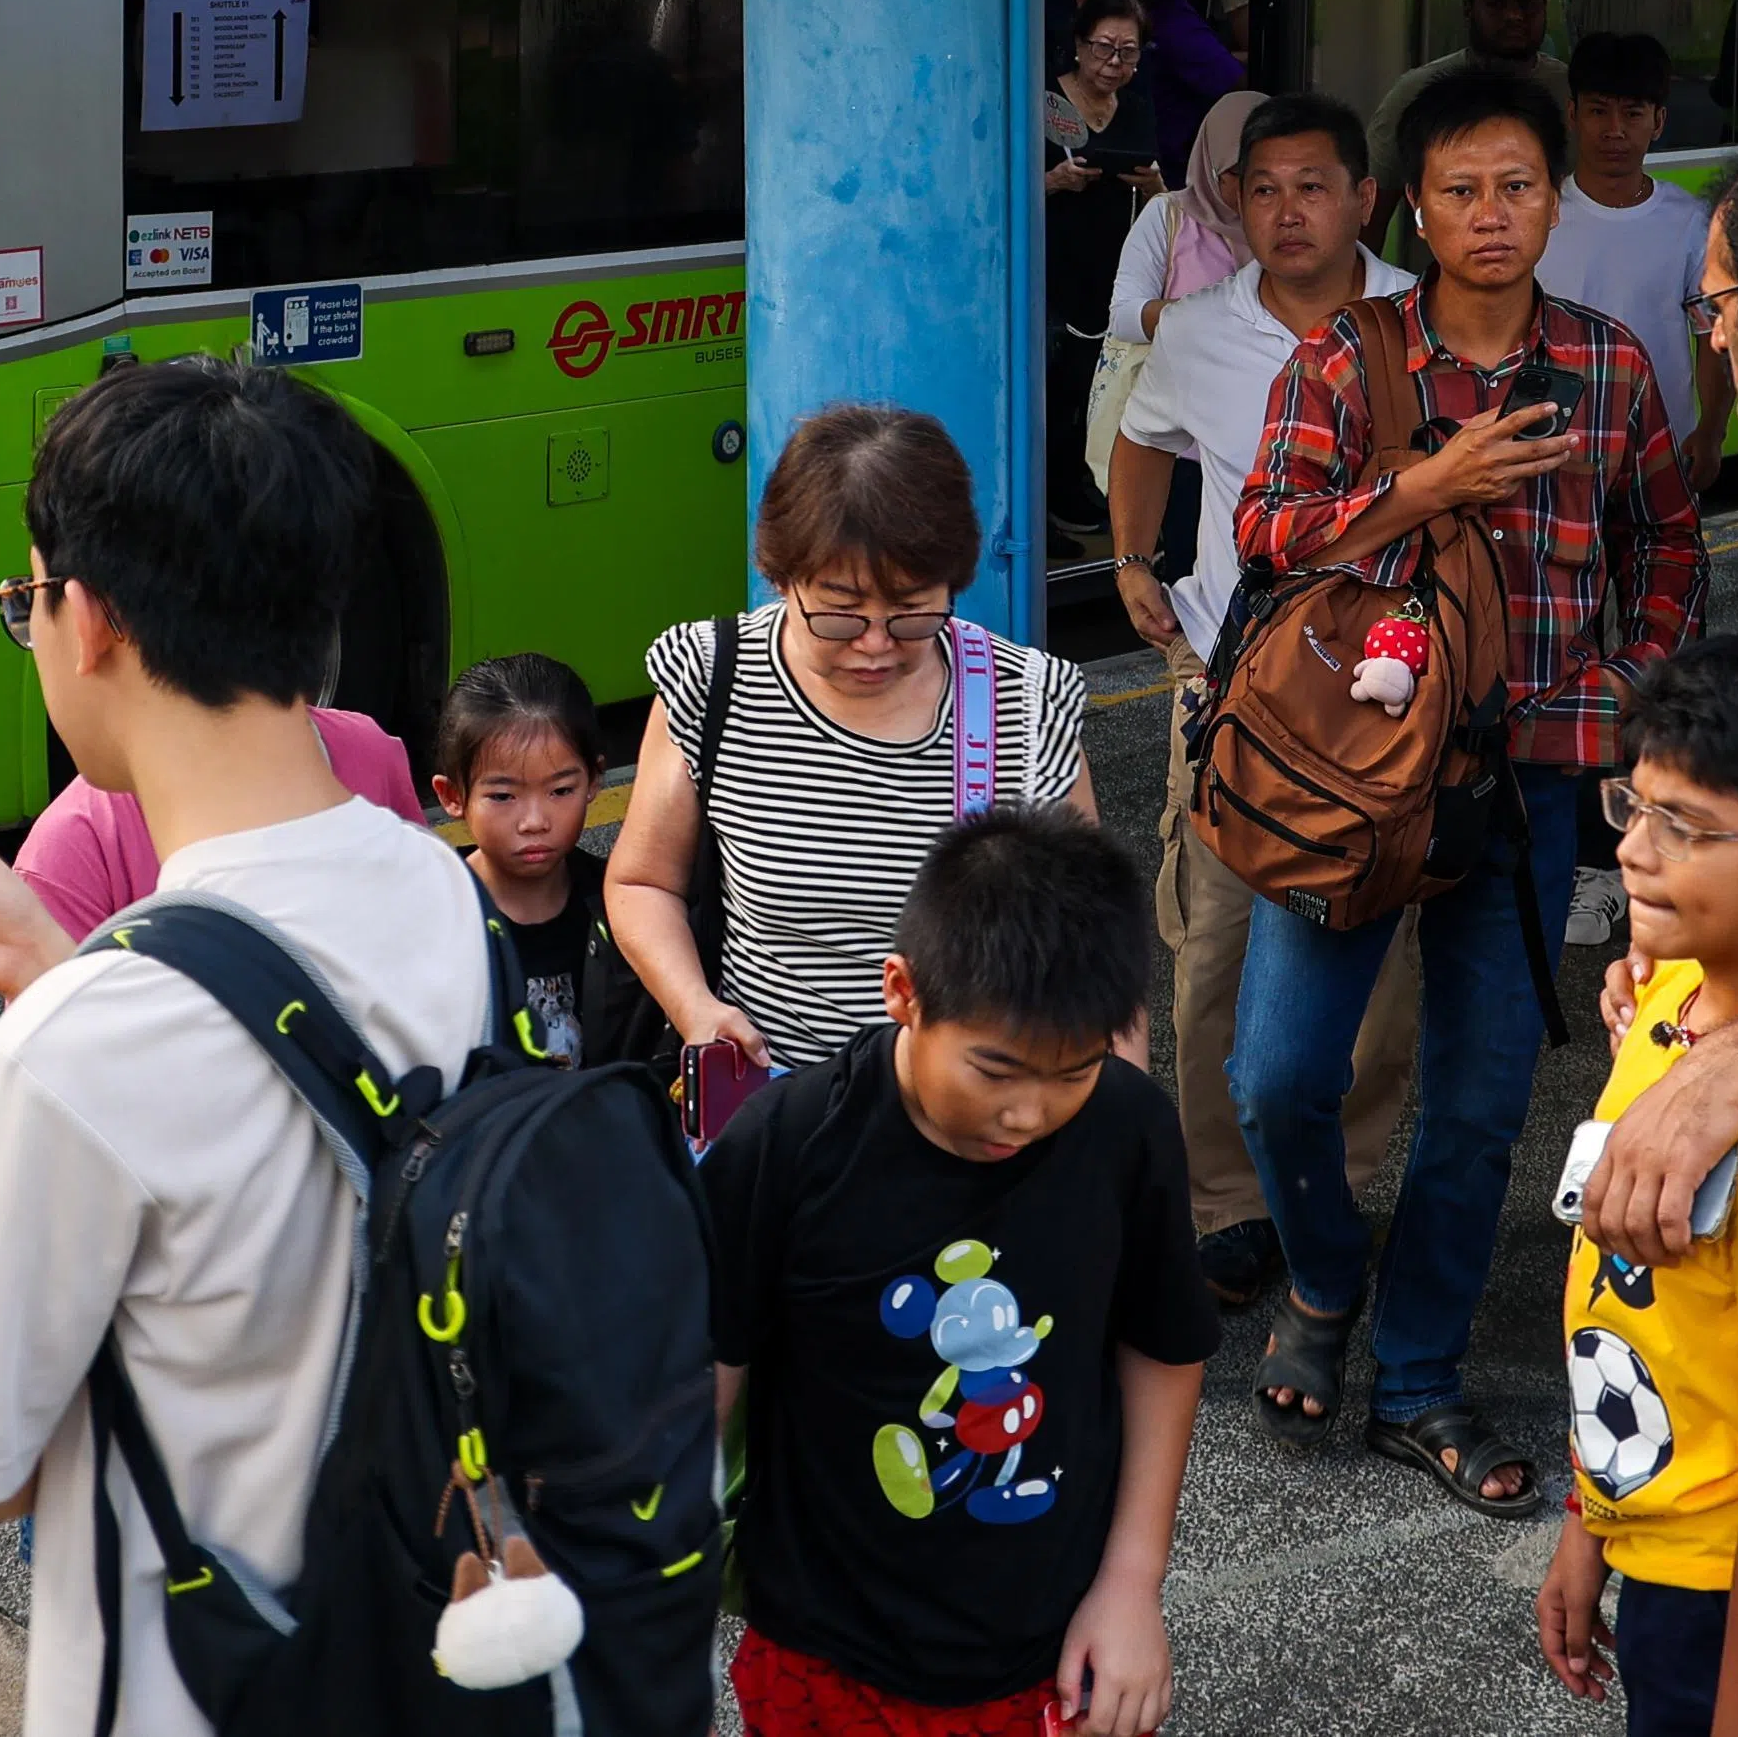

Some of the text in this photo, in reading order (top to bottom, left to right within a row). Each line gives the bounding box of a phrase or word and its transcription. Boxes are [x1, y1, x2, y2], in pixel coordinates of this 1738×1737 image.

[141, 227, 210, 241] ezlink NETS
[179, 247, 209, 261] VISA
[133, 269, 169, 278] Accepted
[183, 267, 205, 275] Board
[314, 298, 358, 310] Please fold
[313, 311, 358, 324] your stroller
[617, 291, 745, 349] SMRT
[320, 325, 332, 334] the
[334, 324, 348, 332] bus
[350, 323, 356, 331] is
[318, 335, 353, 346] crowded
[695, 346, 743, 363] BUSES
